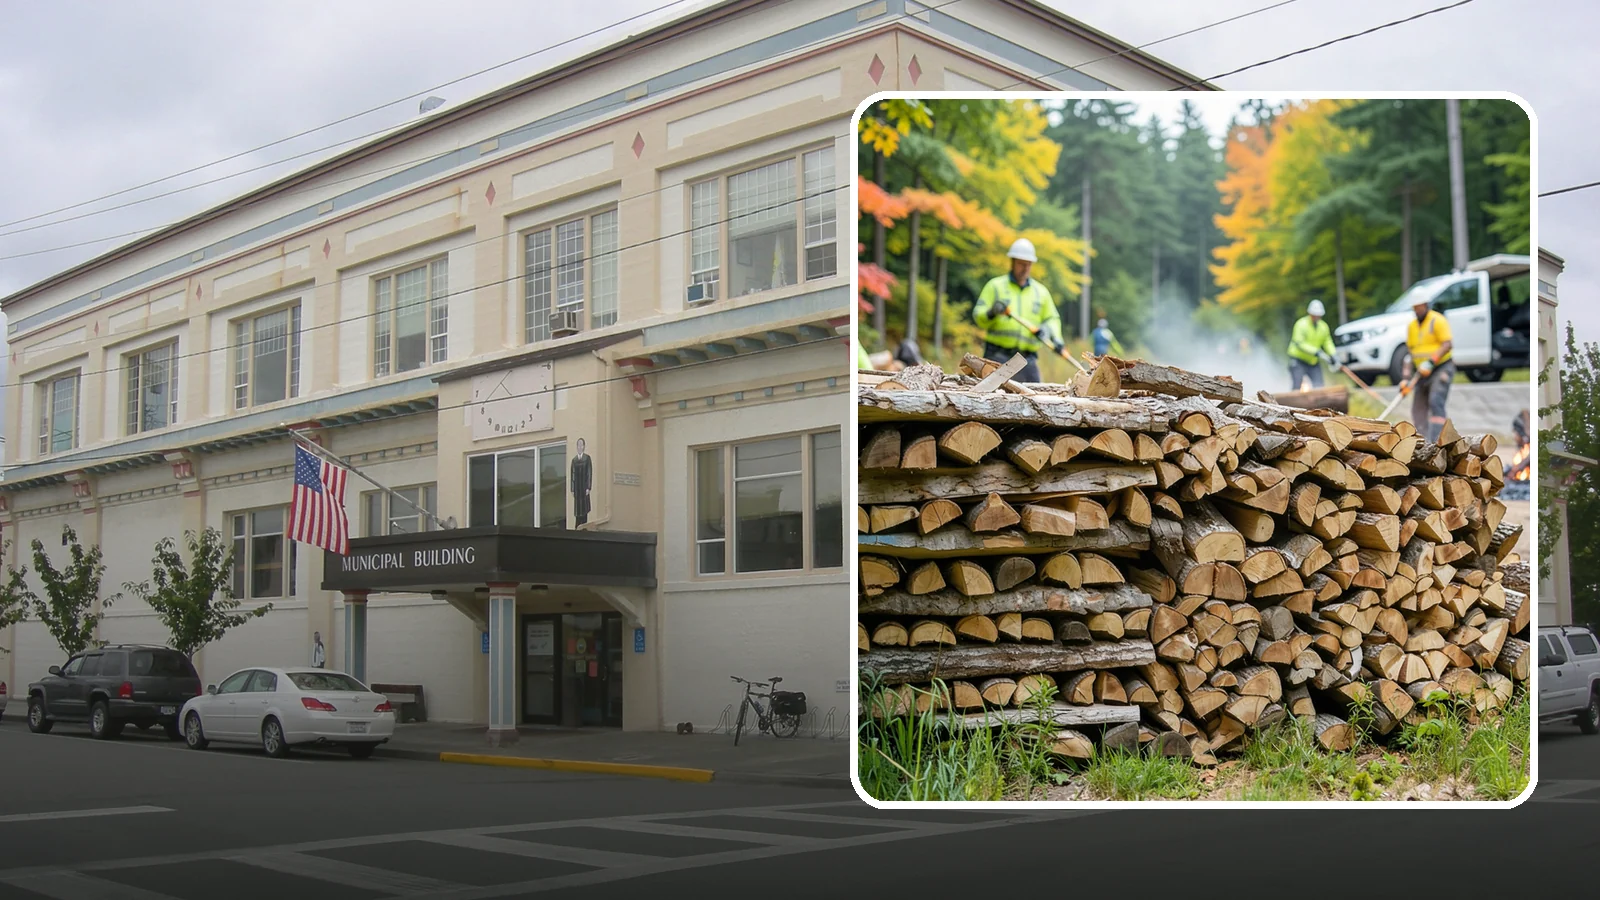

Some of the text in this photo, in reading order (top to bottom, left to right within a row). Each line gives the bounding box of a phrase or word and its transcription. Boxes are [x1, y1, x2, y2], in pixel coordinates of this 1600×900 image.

[480, 406, 485, 415] 8
[487, 417, 492, 425] 9
[529, 413, 533, 422] 3
[494, 423, 500, 431] 10
[501, 425, 506, 433] 11
[507, 425, 513, 433] 12
[342, 546, 475, 572] MUNICIPAL BUILDING
